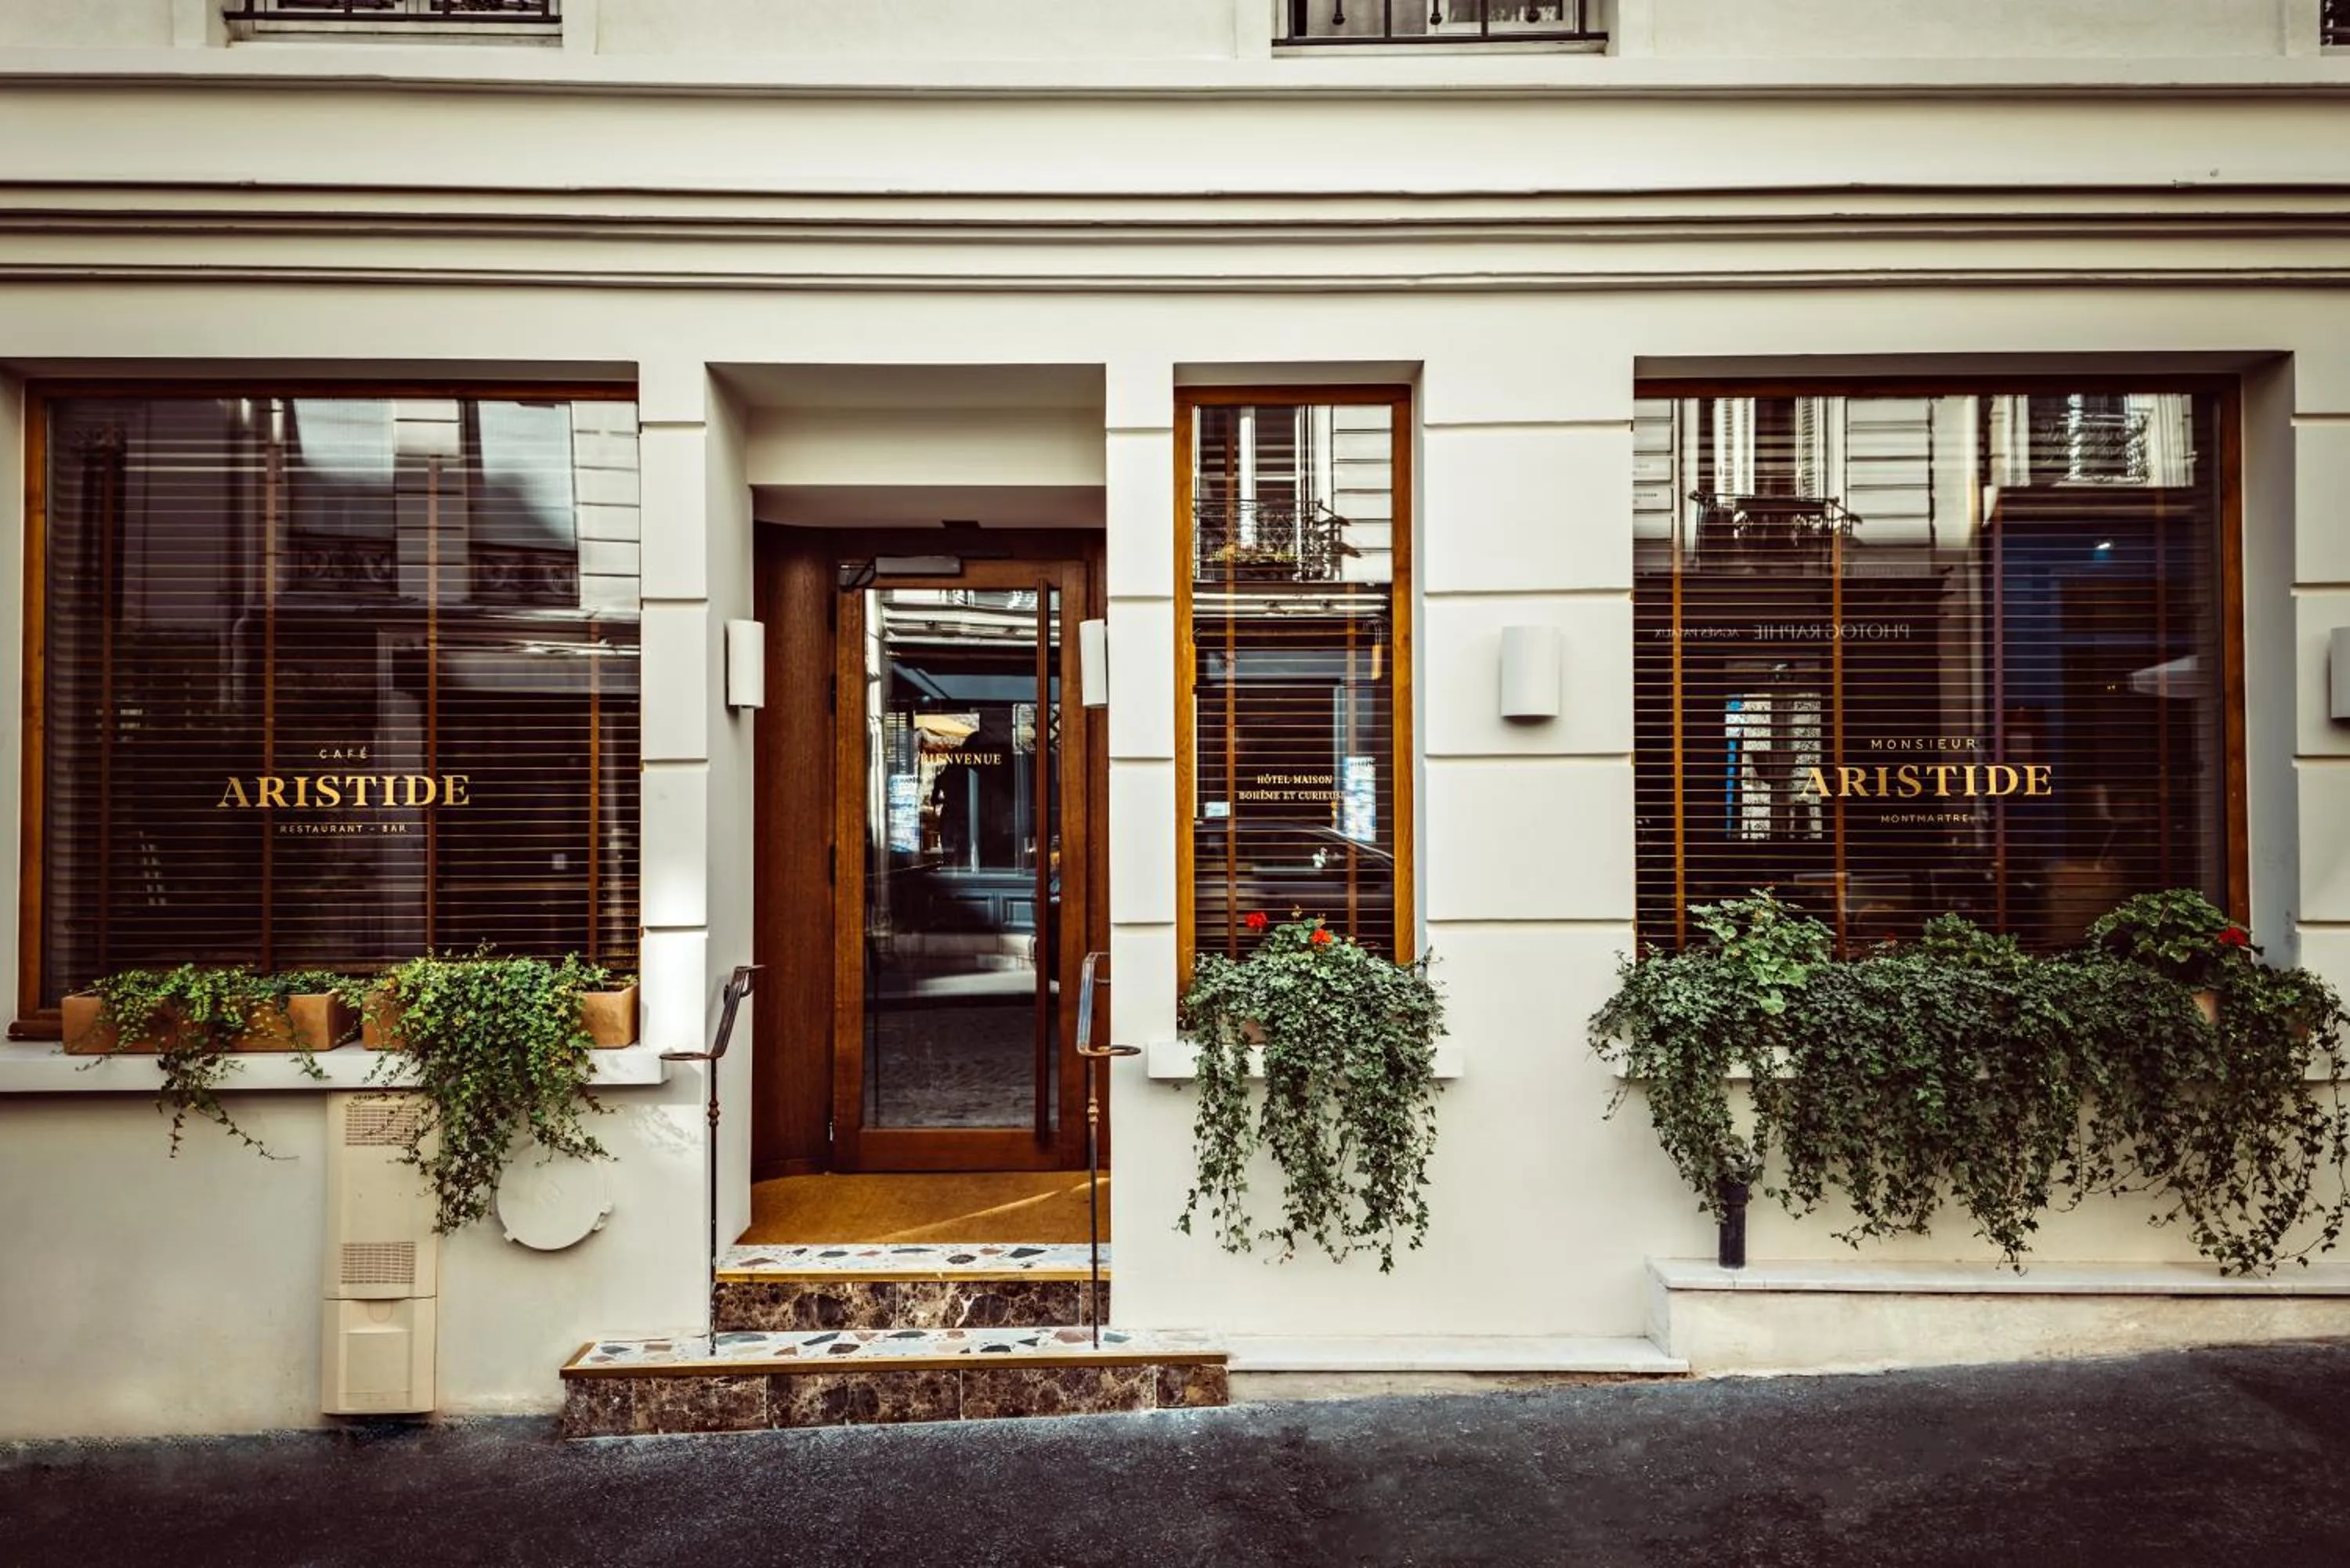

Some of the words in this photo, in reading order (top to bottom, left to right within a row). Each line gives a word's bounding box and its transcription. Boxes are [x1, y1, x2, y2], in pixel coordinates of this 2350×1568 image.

[1871, 739, 1976, 750] MONSIEUR
[318, 746, 369, 759] CAFÉ
[920, 753, 1003, 765] BIENVENUE
[1801, 764, 2052, 797] ARISTIDE
[216, 774, 470, 808] ARISTIDE
[1283, 790, 1295, 800] ET
[1881, 815, 1969, 823] MONTMARTRE
[280, 825, 363, 833] RESTAURANT
